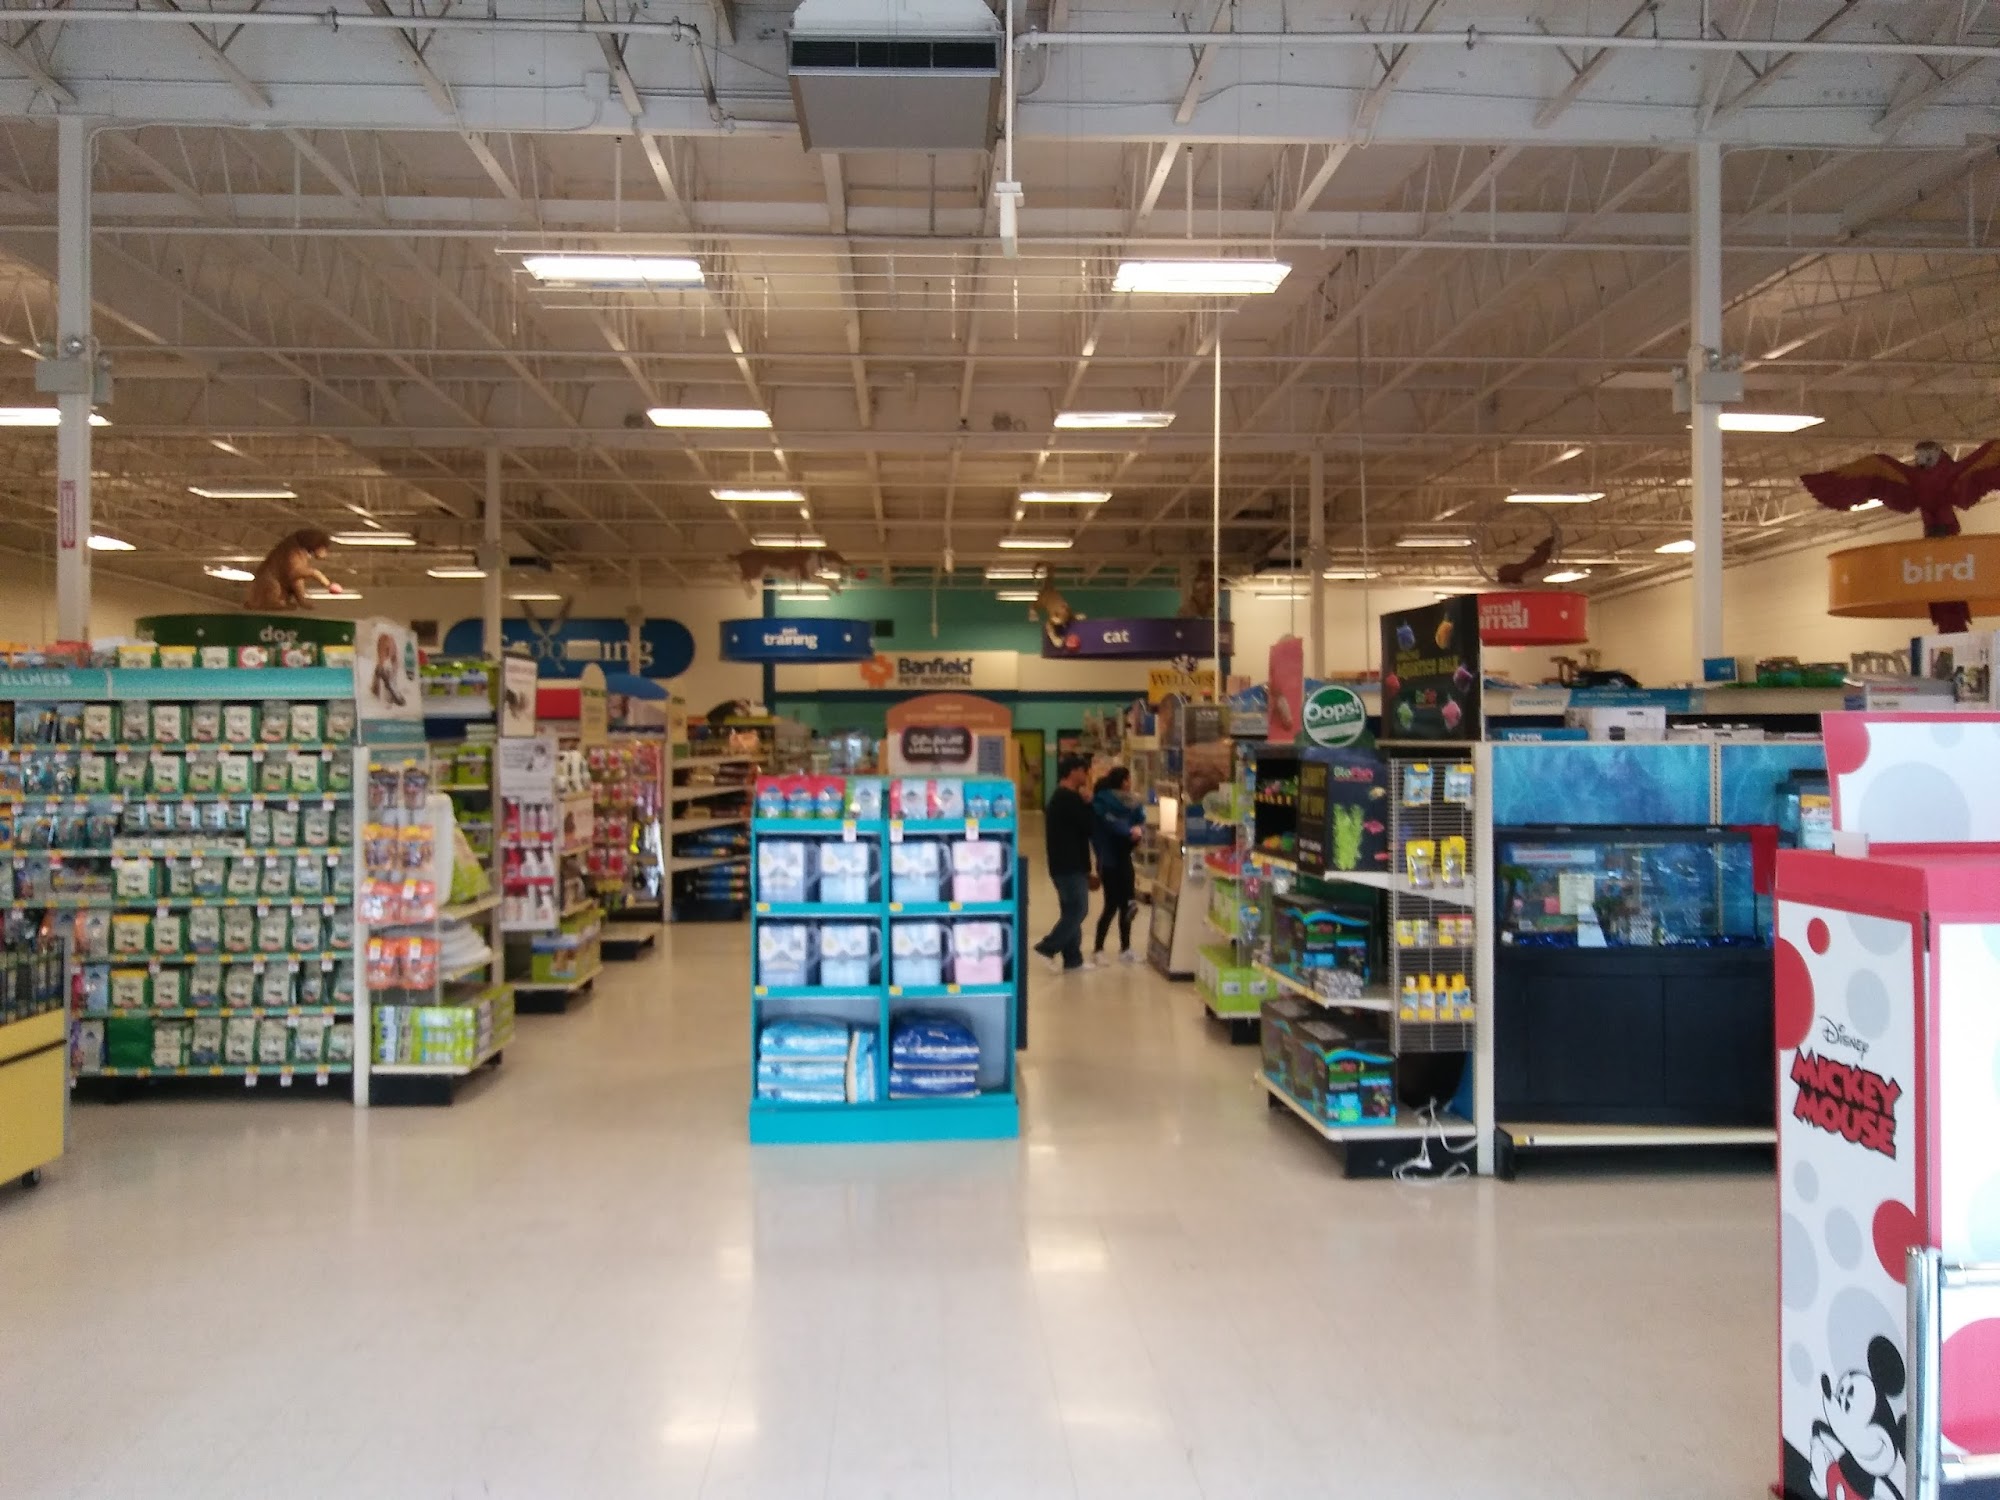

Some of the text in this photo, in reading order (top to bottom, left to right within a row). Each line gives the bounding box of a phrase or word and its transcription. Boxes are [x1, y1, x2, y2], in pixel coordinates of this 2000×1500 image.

[1903, 553, 1976, 585] bird
[1482, 599, 1521, 616] small
[260, 624, 298, 644] dog
[763, 632, 818, 650] training
[1102, 629, 1129, 644] cat
[898, 657, 974, 675] Banfield
[899, 677, 972, 687] PET HOSPITAL
[1306, 696, 1362, 722] Oops!
[1820, 1015, 1870, 1061] Disney
[1790, 1046, 1902, 1119] MICKEY
[1793, 1088, 1897, 1161] MOUSE
